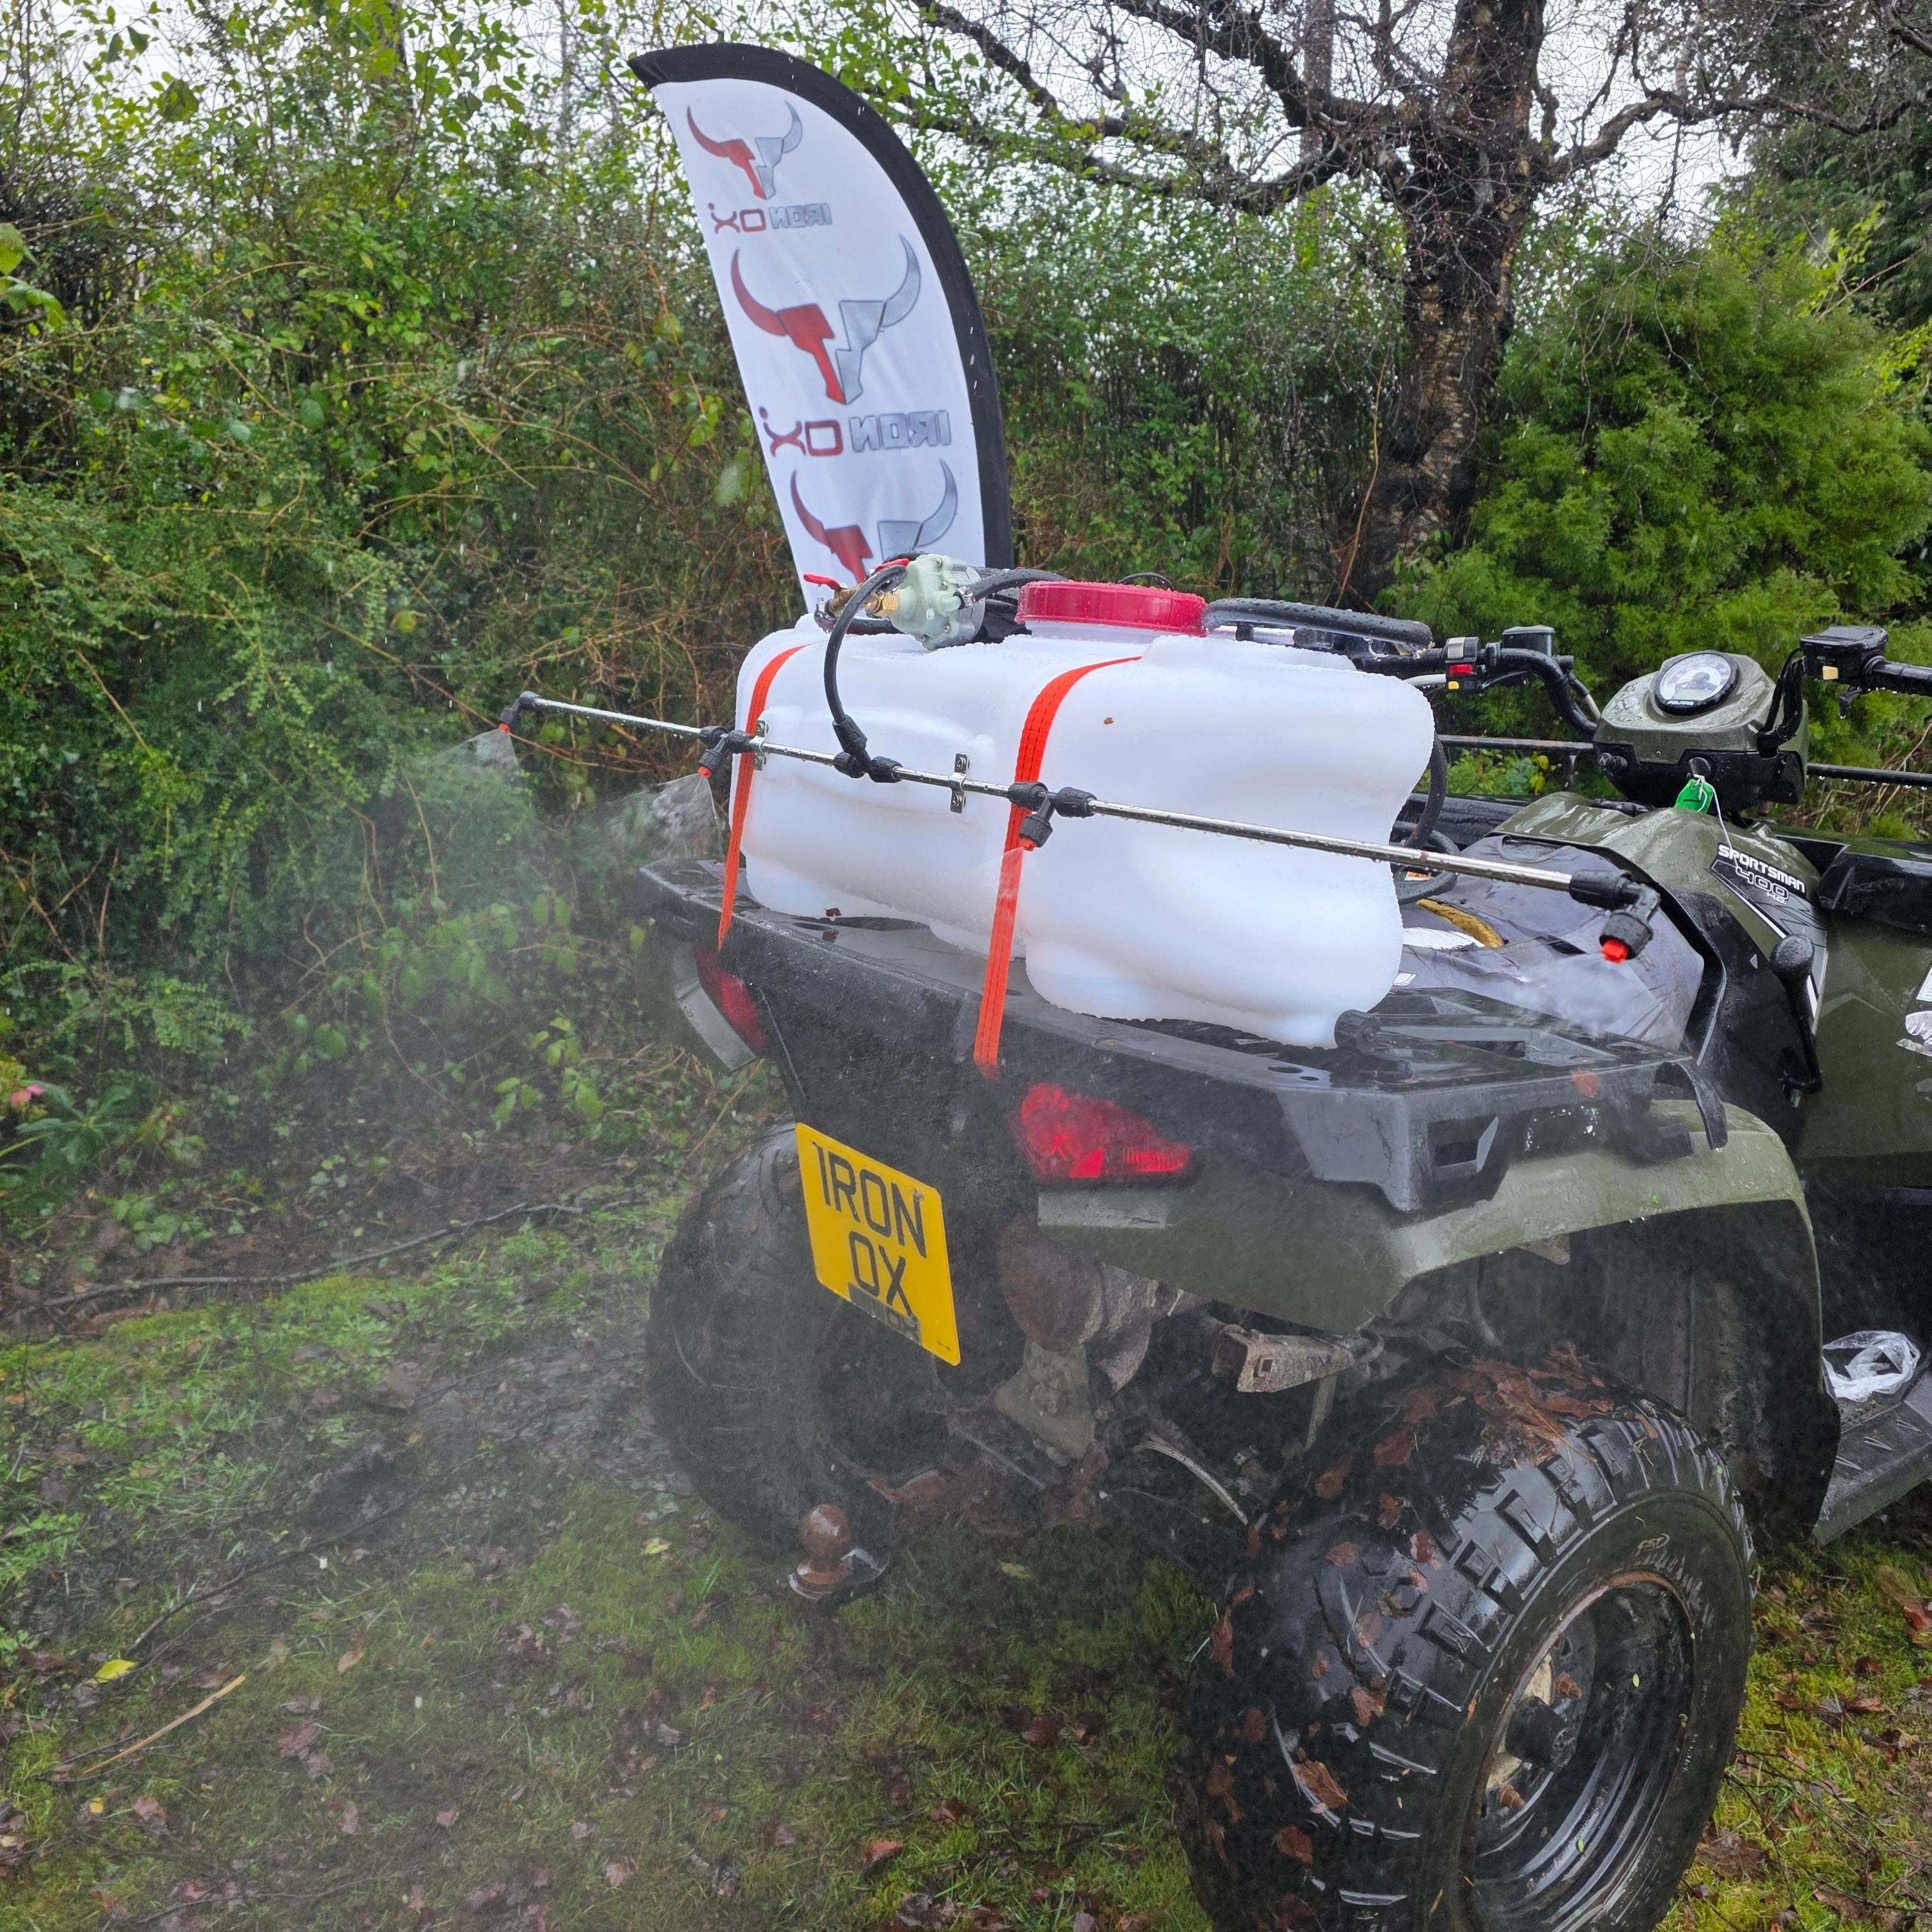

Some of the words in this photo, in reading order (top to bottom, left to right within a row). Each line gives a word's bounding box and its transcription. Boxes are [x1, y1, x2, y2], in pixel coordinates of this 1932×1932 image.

[1718, 844, 1805, 893] SPORTSMAN
[1736, 865, 1789, 900] 400
[849, 1231, 912, 1317] OX
